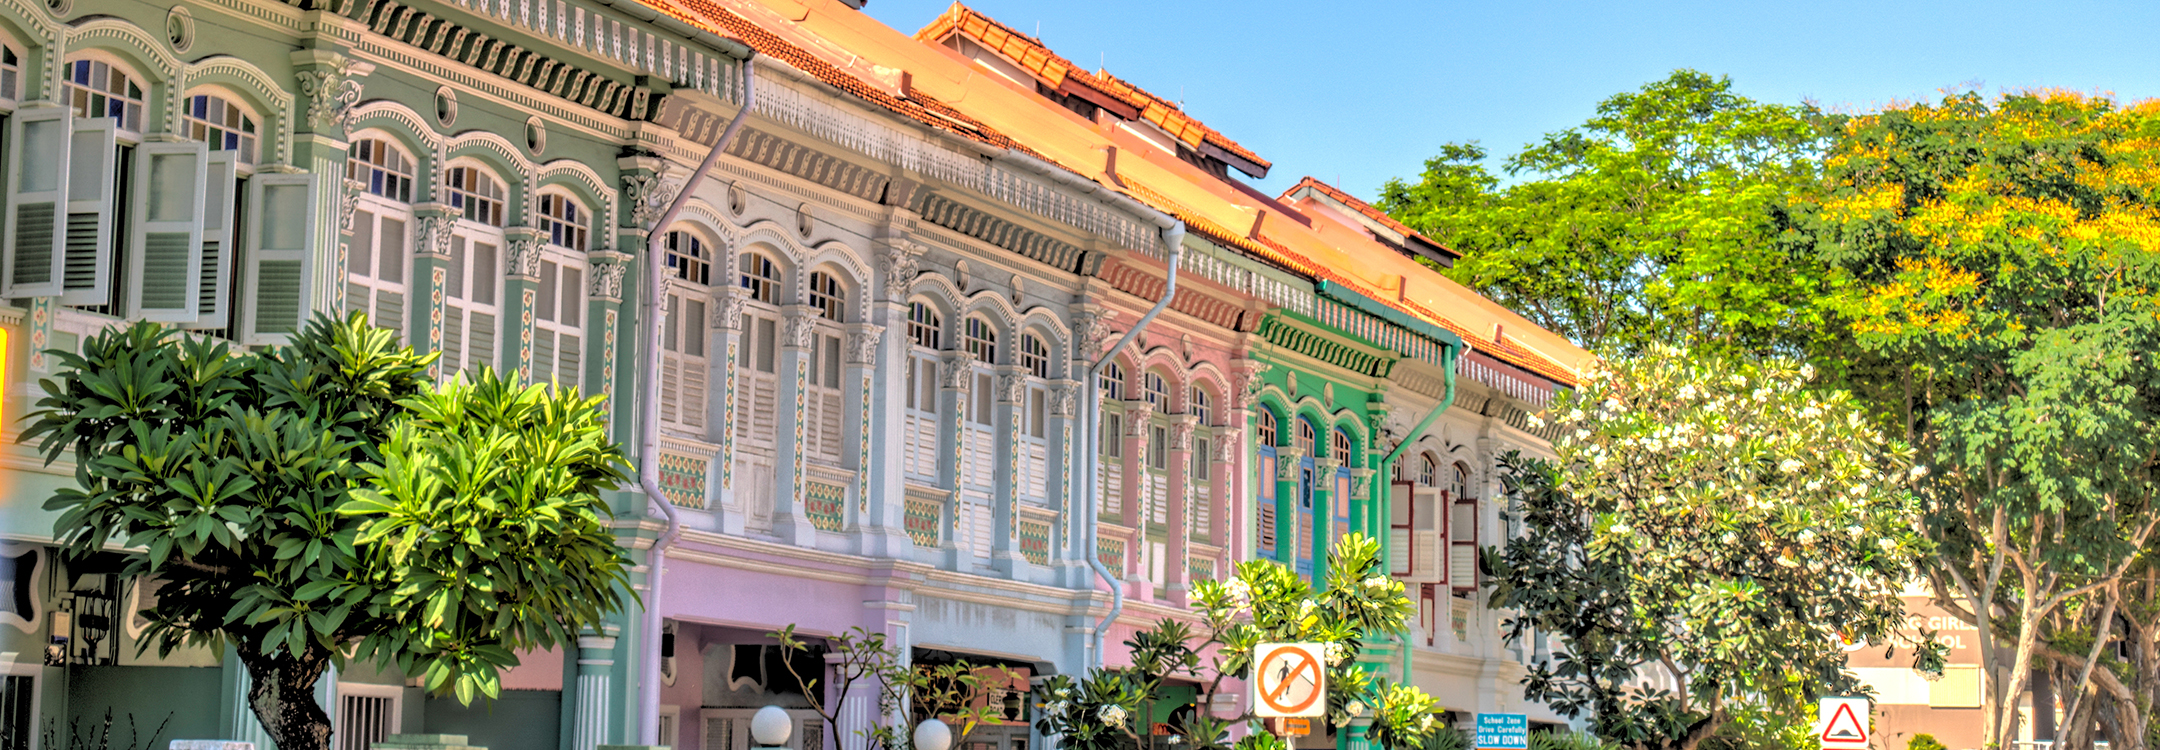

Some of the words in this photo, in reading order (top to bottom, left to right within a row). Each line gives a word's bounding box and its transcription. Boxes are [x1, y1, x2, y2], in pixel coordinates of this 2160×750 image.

[1888, 635, 1967, 649] SCHOL
[1484, 716, 1503, 724] School
[1507, 716, 1521, 724] Zone
[1498, 726, 1525, 734] Carefully
[1478, 735, 1500, 745] SLOW
[1502, 735, 1526, 745] DOWN
